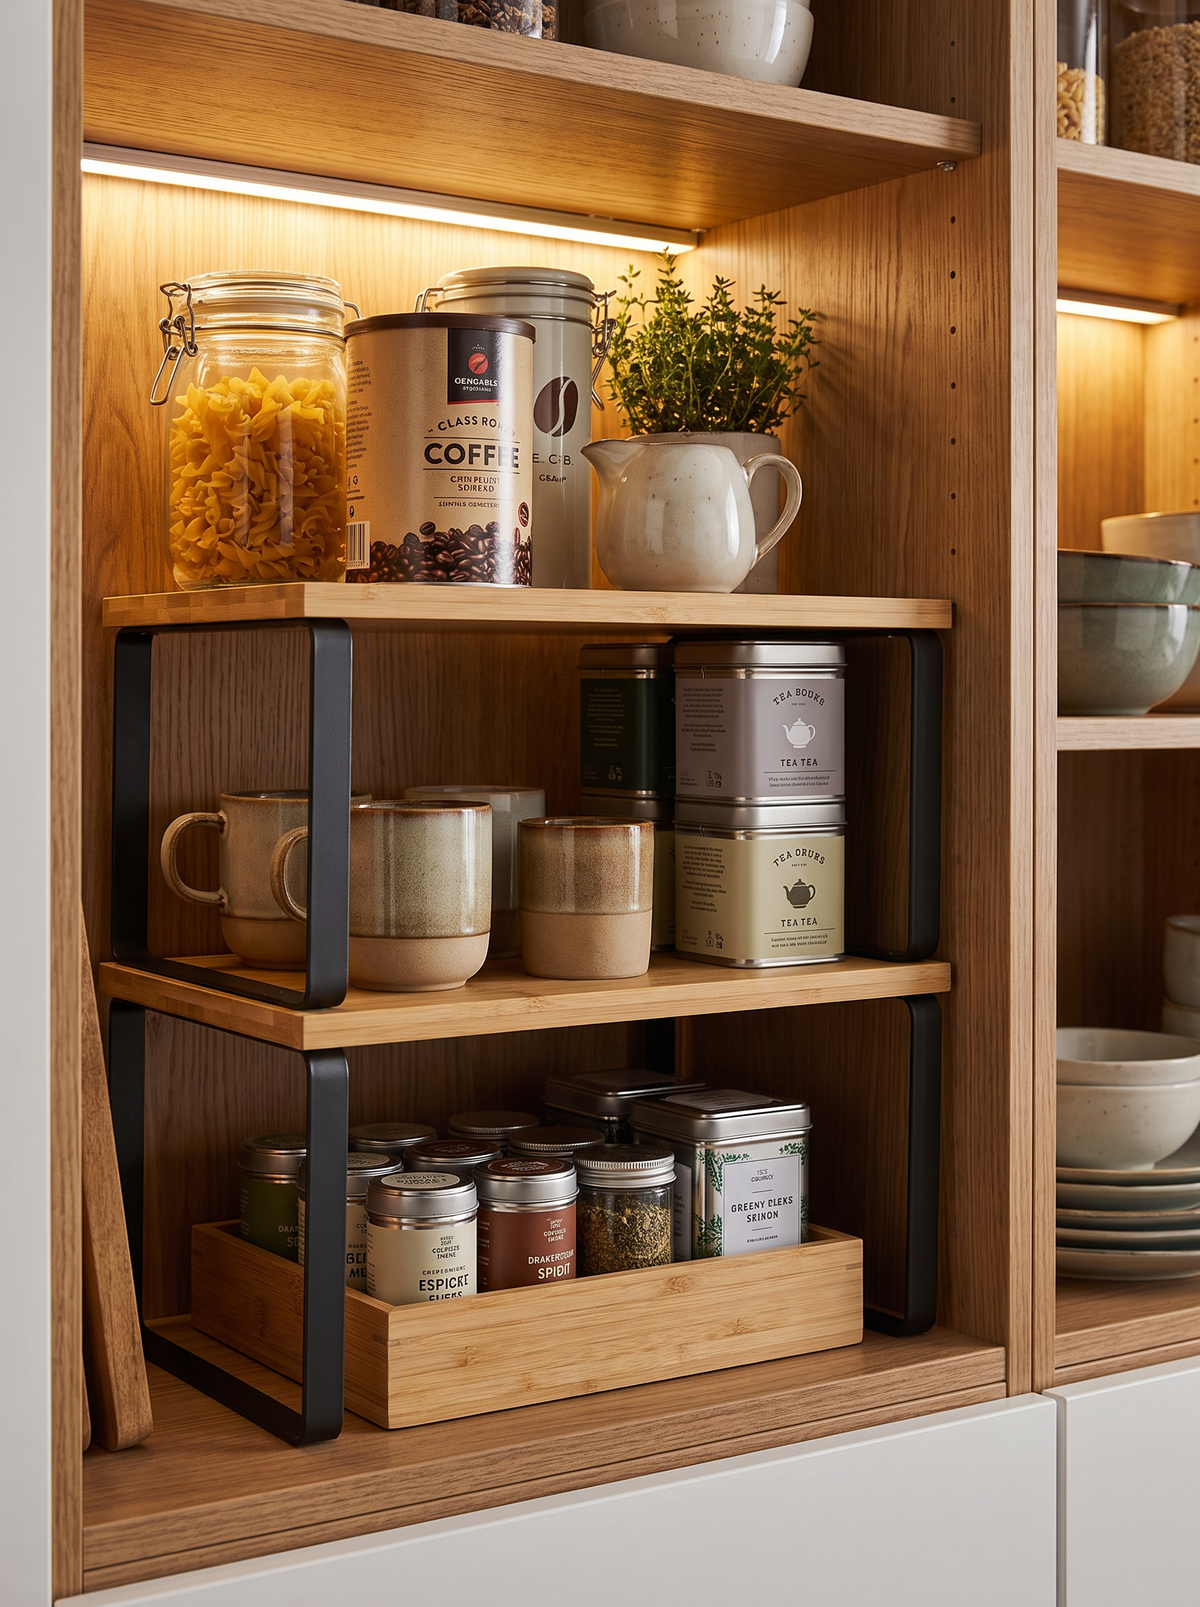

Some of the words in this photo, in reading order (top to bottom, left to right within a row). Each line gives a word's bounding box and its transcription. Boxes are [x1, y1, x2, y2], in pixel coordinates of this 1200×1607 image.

[437, 416, 478, 431] CLASS
[424, 442, 519, 469] COFFEE
[773, 690, 792, 706] TEA
[780, 759, 798, 767] TEA
[800, 758, 818, 766] TEA
[773, 851, 792, 867] TEA
[780, 919, 798, 927] TEA
[800, 917, 818, 926] TEA
[731, 1200, 765, 1213] GREENY
